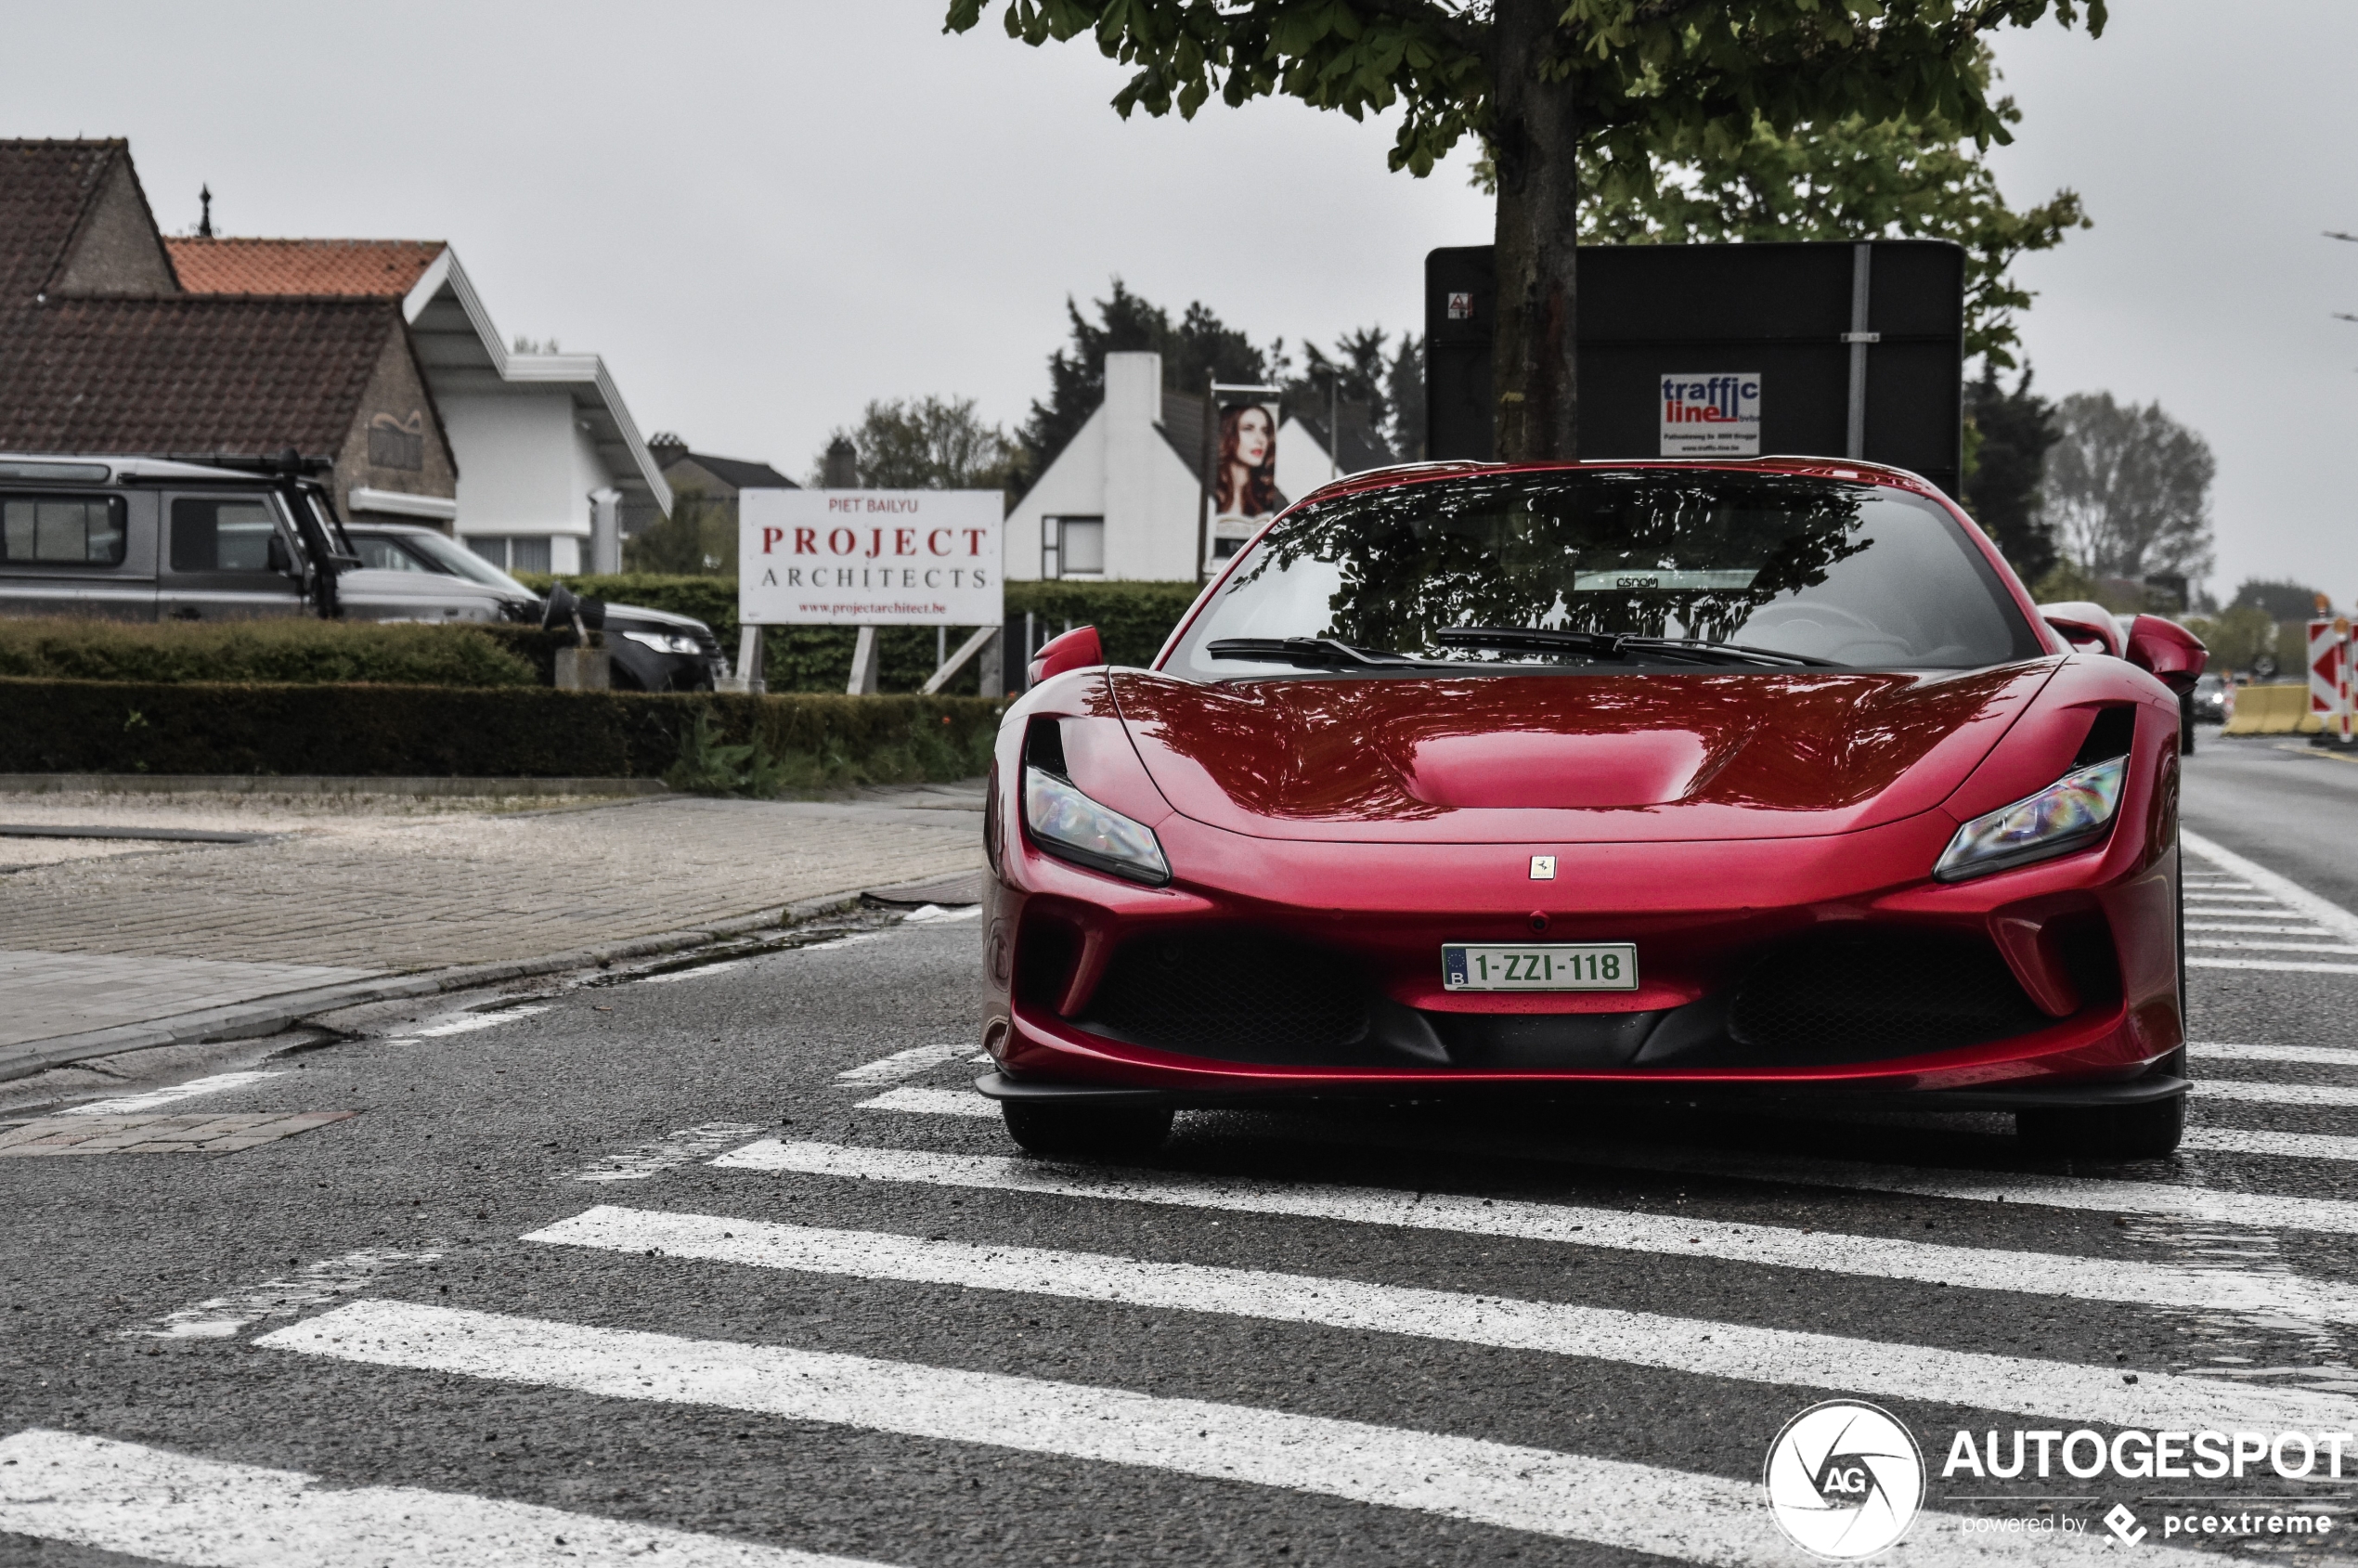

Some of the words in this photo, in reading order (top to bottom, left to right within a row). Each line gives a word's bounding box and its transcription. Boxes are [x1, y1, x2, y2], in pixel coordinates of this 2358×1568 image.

[1663, 377, 1758, 418] traffic
[1666, 400, 1738, 422] line
[829, 499, 861, 512] PIET
[867, 499, 918, 513] BAILYU
[761, 526, 987, 559] PROJECT
[761, 568, 987, 590] ARCHITECTS
[798, 603, 947, 616] www.projectarchitect.be
[1475, 953, 1620, 981] 1-ZZI-118
[1451, 972, 1465, 985] B
